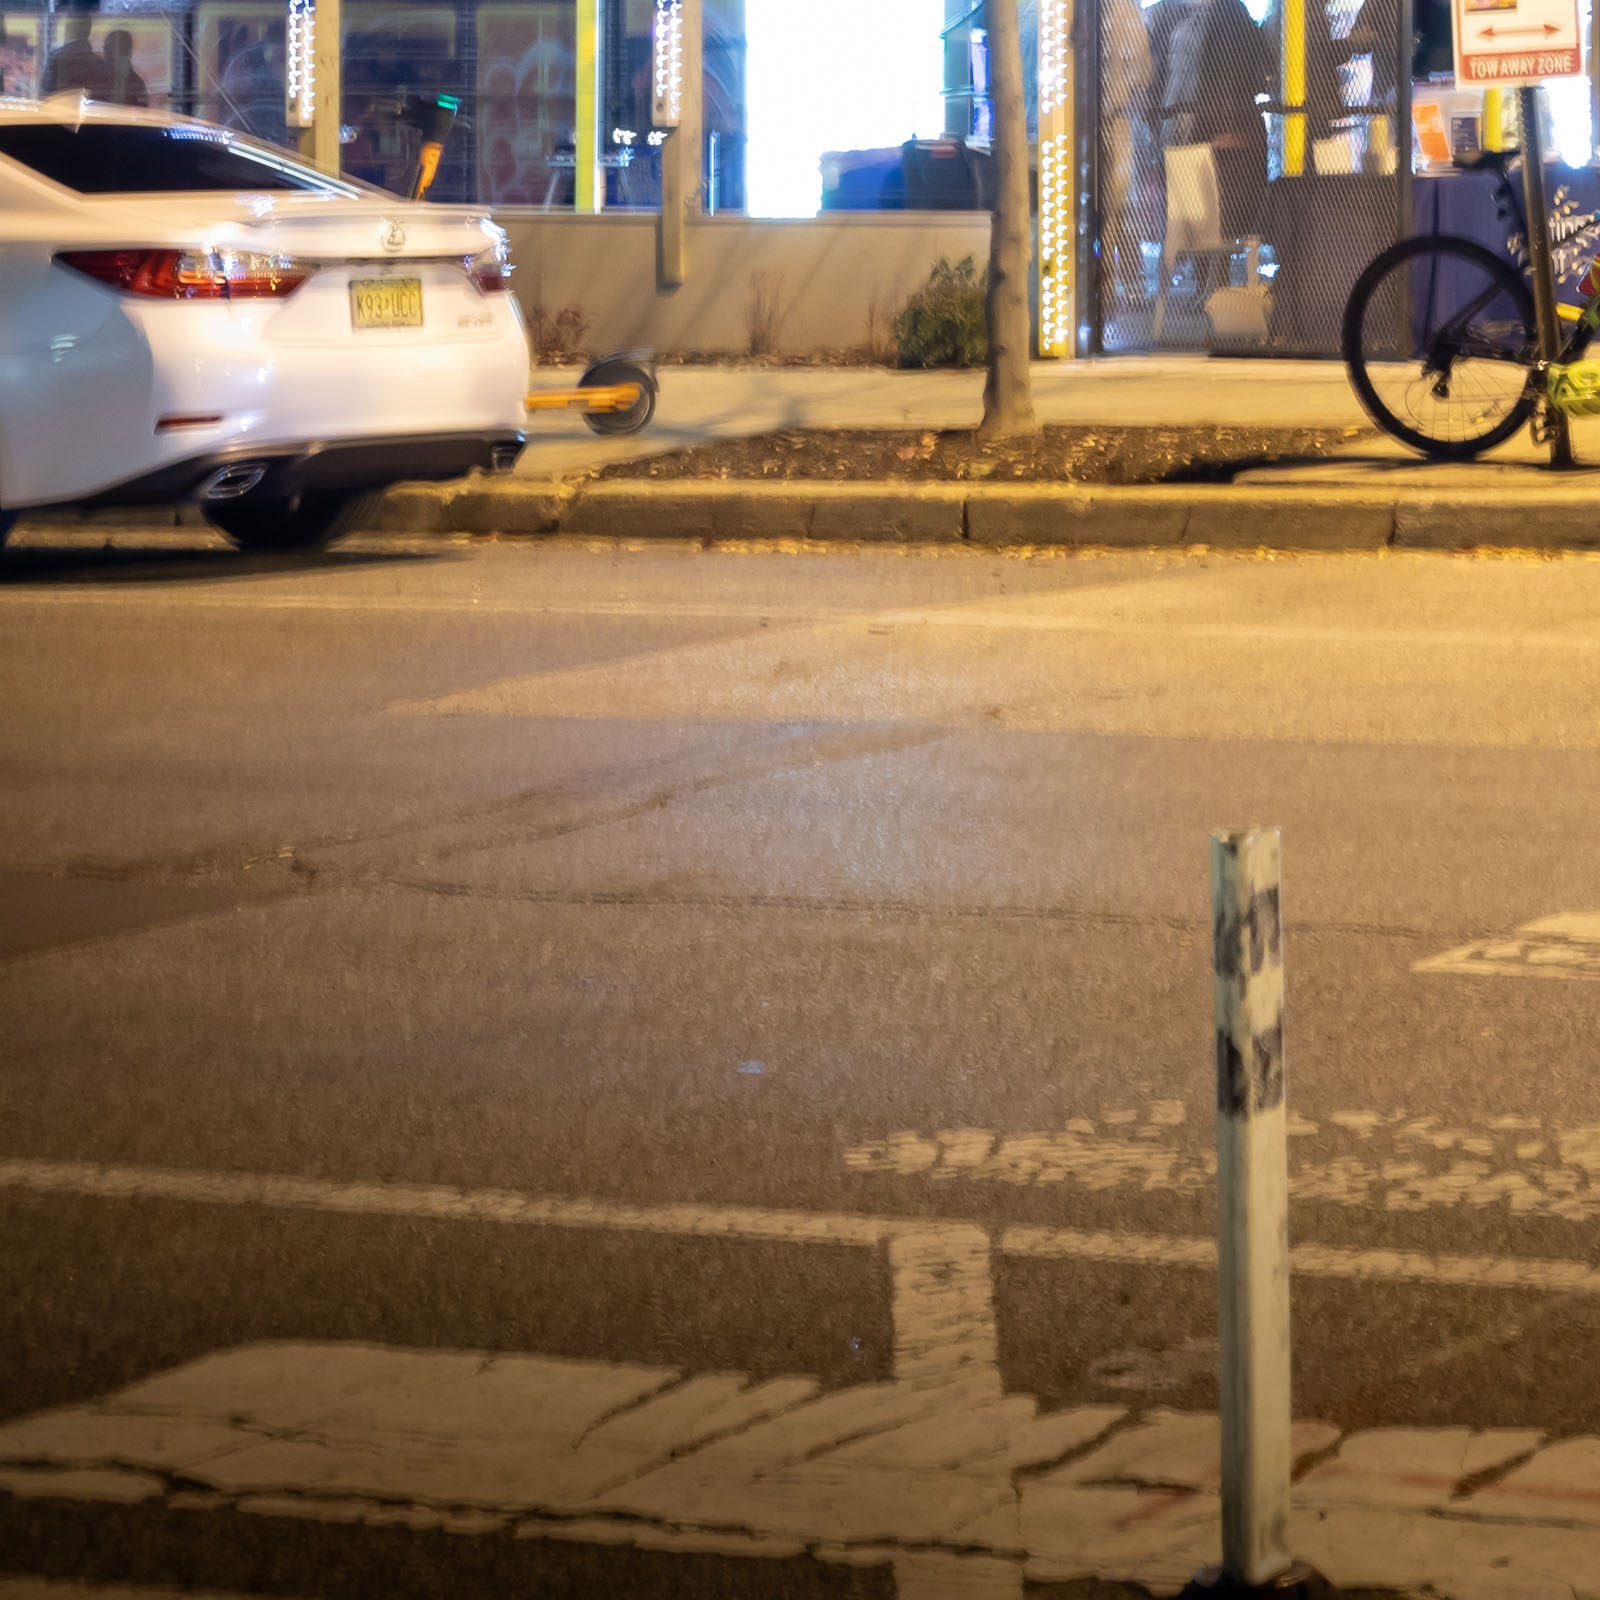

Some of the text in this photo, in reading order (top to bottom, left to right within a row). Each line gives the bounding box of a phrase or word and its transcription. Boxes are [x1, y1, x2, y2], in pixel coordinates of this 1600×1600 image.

[1470, 54, 1573, 79] TOW AWAY ZONE
